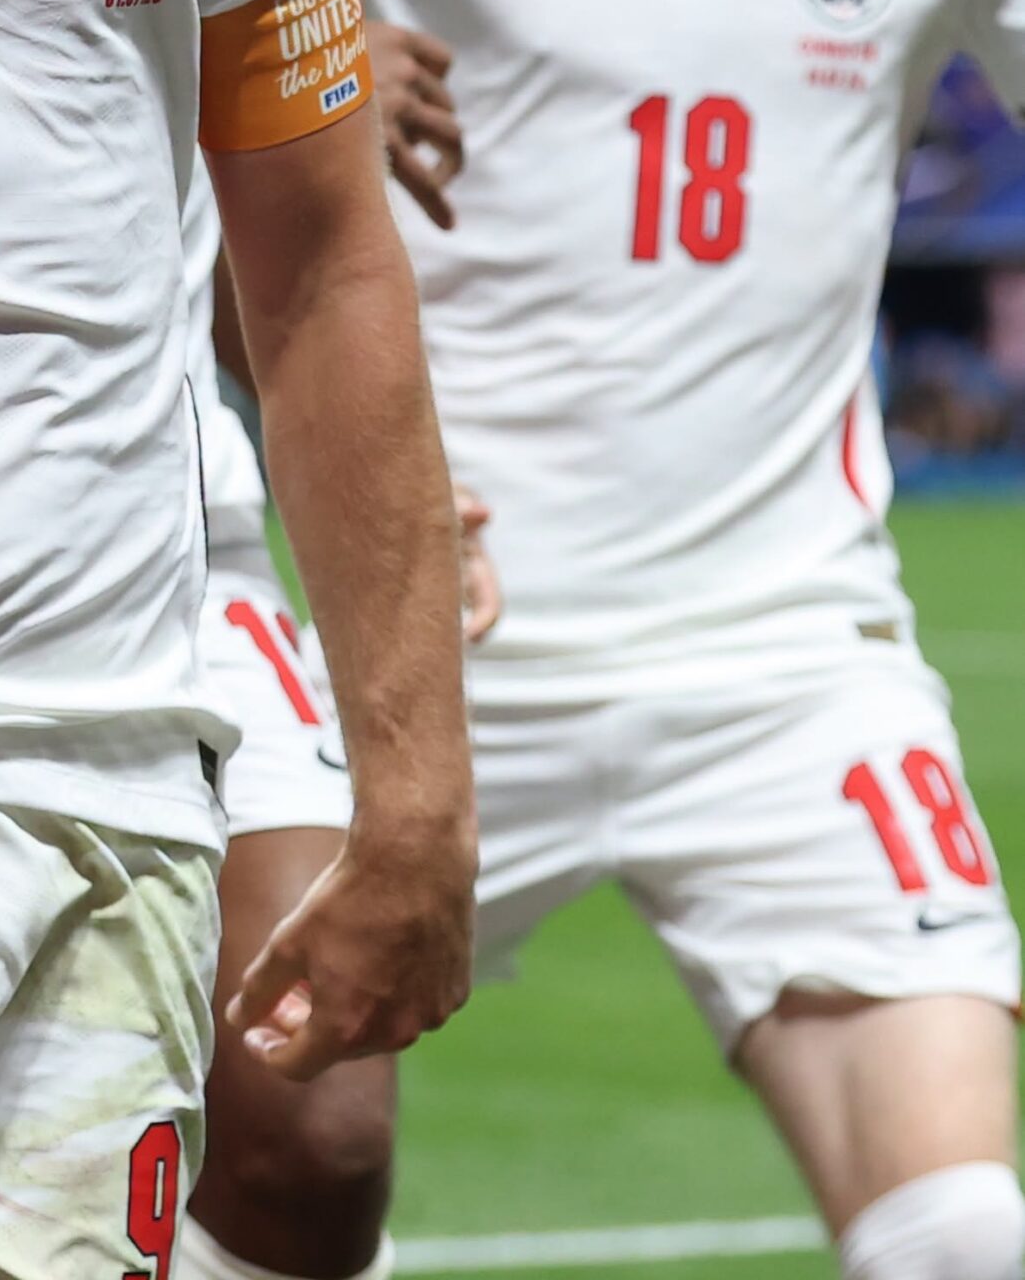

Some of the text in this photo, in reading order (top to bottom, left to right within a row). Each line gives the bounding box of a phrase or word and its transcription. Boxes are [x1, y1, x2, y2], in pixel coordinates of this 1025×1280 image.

[275, 61, 322, 99] the
[324, 78, 357, 109] FIFA
[629, 93, 753, 264] 18
[224, 600, 321, 726] 1
[840, 747, 991, 894] 18
[121, 1120, 181, 1280] 9
